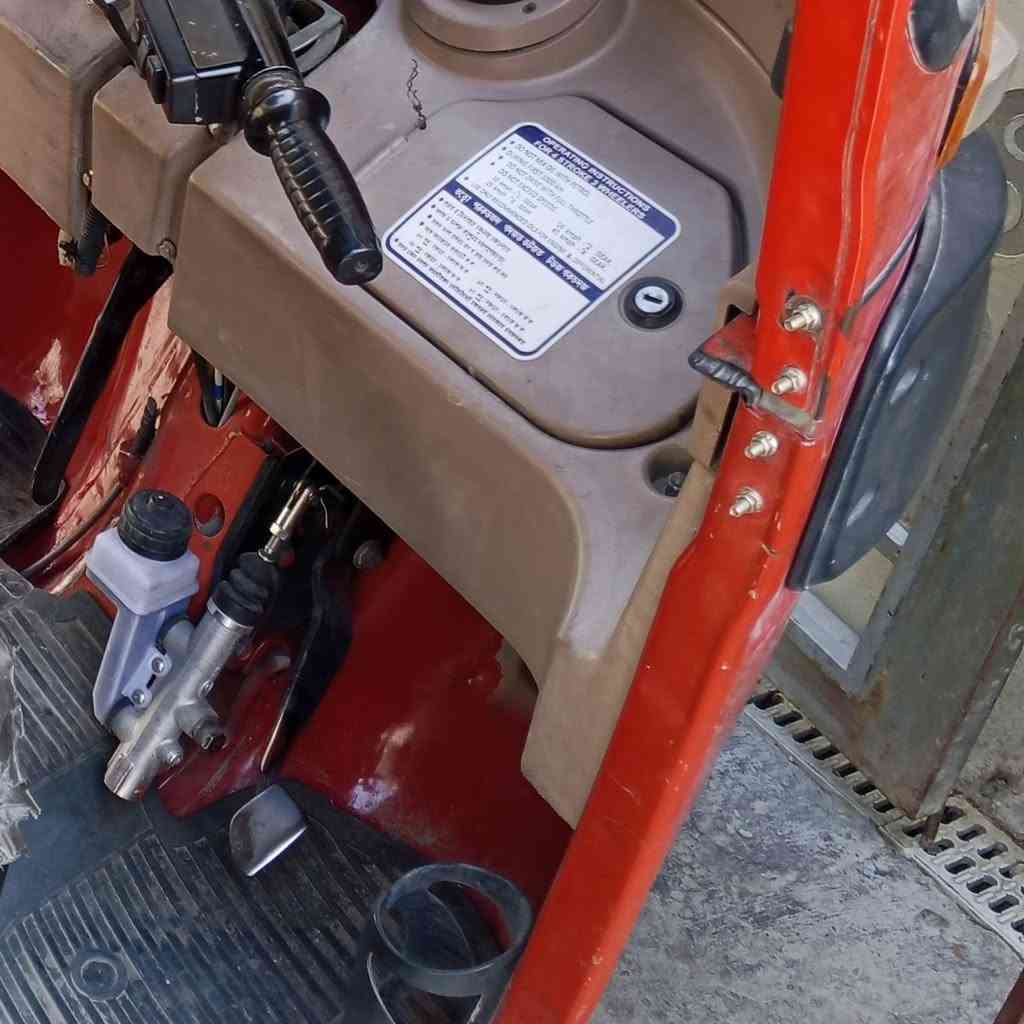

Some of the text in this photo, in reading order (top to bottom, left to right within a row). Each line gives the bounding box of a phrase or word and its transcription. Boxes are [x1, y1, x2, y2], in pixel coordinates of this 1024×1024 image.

[534, 140, 553, 155] FOR
[558, 156, 593, 183] STROKE
[597, 183, 647, 219] WHEELERS
[543, 136, 588, 170] OPERATING
[588, 165, 652, 212] INSTRUCTIONS
